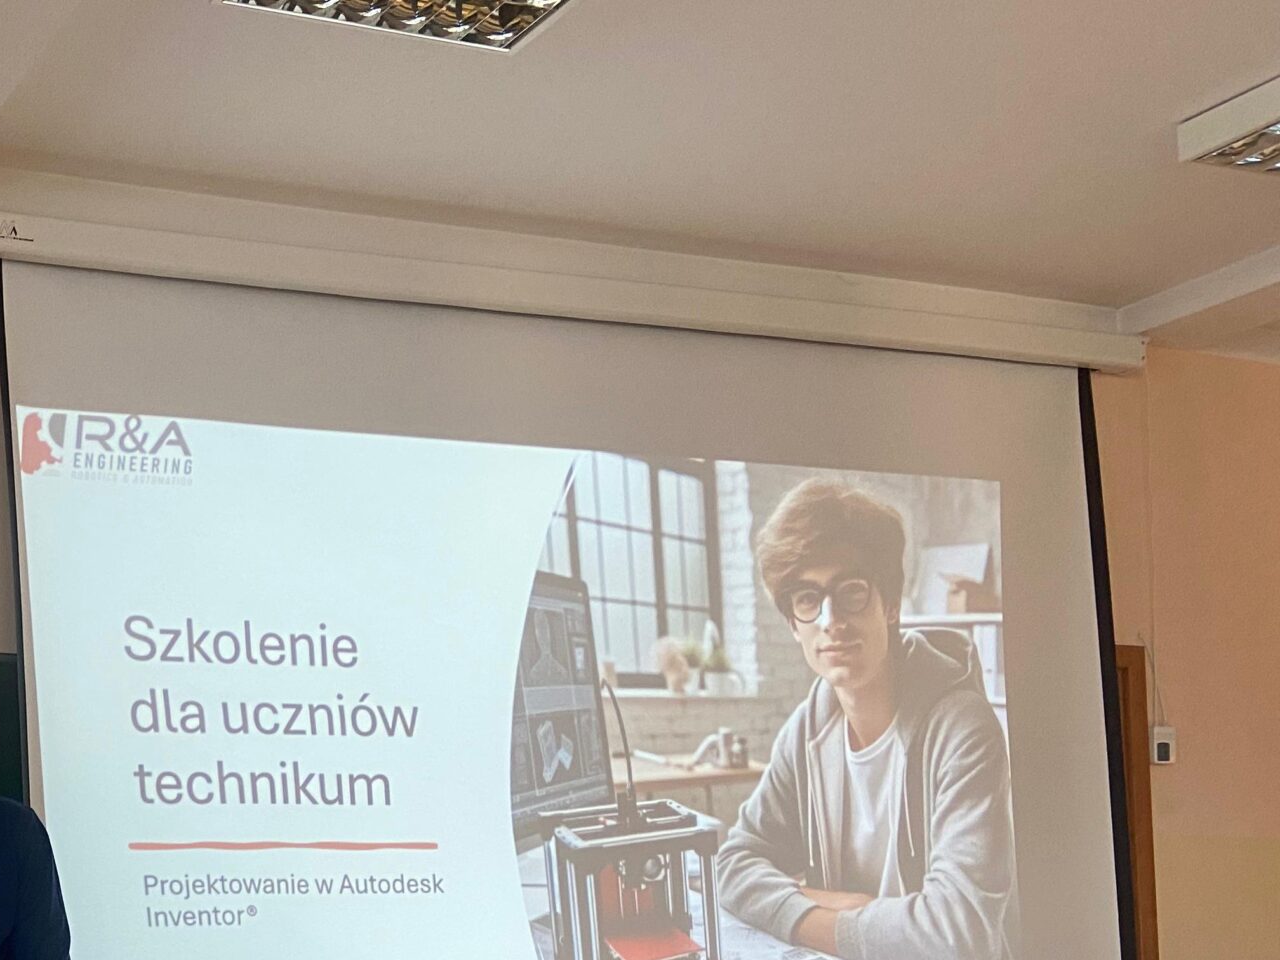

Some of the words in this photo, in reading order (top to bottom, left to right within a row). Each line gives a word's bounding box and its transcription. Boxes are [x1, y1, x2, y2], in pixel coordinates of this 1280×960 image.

[75, 413, 192, 457] R&A
[73, 452, 193, 475] ENGINEERING
[124, 615, 359, 668] Szkolenie
[130, 688, 207, 735] dla
[221, 692, 419, 738] uczniów
[133, 760, 392, 806] technikum
[143, 873, 310, 900] Projektowanie
[315, 877, 334, 896] w
[339, 873, 445, 895] Autodesk
